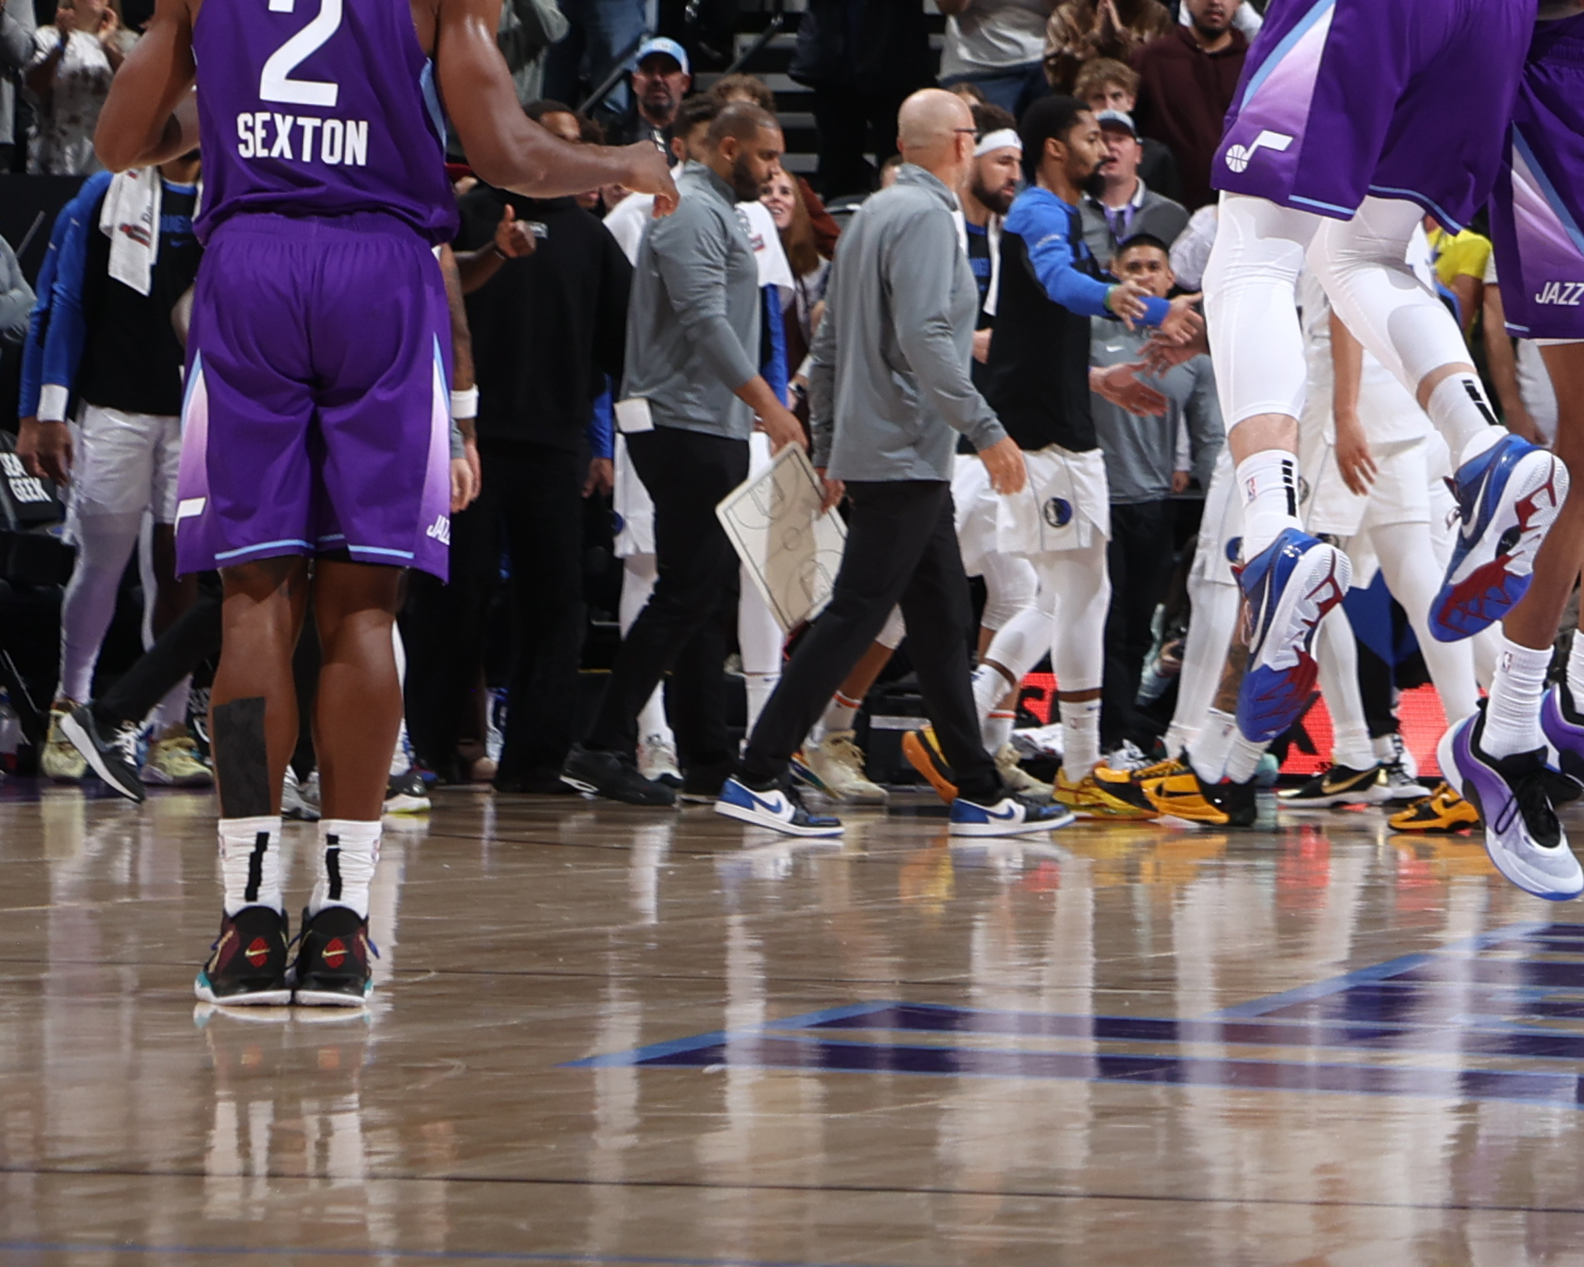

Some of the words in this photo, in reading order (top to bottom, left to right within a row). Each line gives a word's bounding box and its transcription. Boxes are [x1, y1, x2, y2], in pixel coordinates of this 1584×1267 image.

[236, 112, 369, 167] SEXTON
[0, 451, 29, 477] SEA
[8, 477, 53, 504] GEEK
